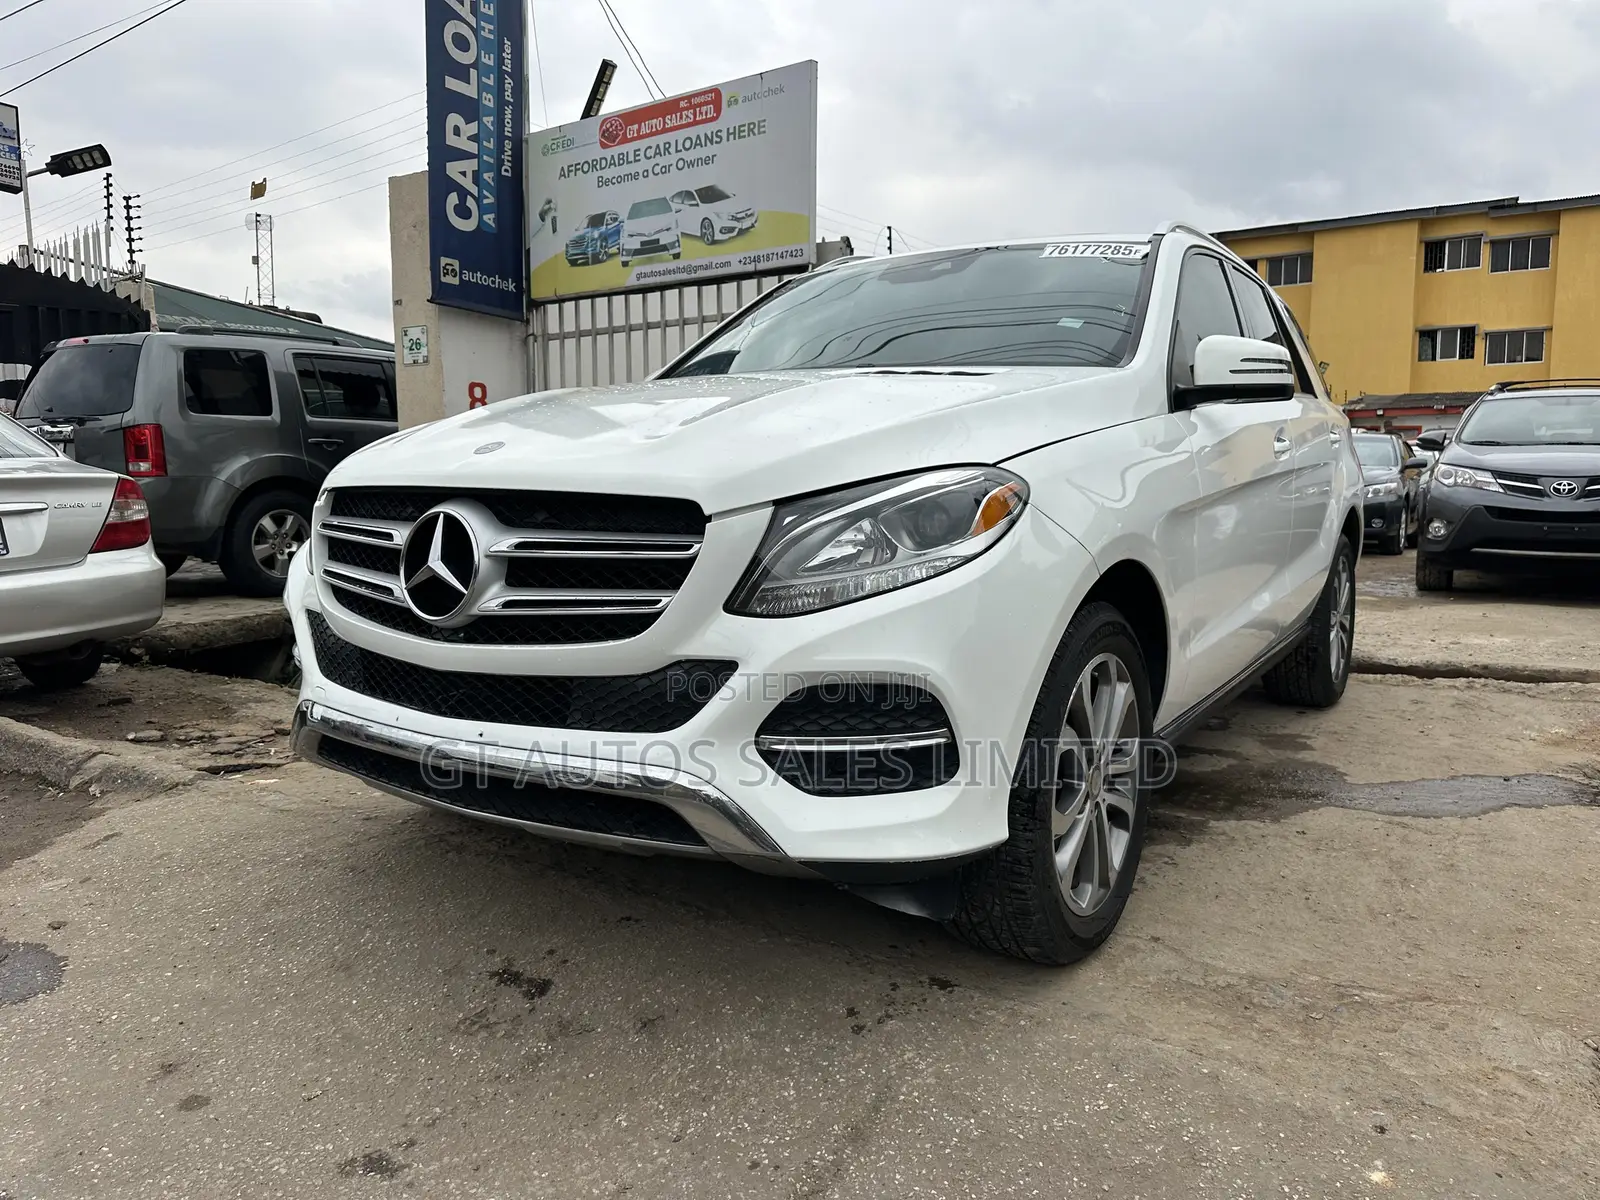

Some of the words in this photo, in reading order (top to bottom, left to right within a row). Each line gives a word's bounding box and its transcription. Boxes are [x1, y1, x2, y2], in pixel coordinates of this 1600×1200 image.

[502, 37, 512, 73] later
[504, 75, 514, 102] pay
[679, 98, 691, 109] RC.
[741, 84, 786, 104] autochek
[503, 105, 514, 138] now,
[626, 125, 640, 139] GT
[640, 117, 663, 136] AUTO
[665, 109, 694, 128] SALES
[695, 104, 717, 124] LTD.
[481, 51, 497, 228] AVAILABLE
[558, 148, 641, 180] AFFORDABLE
[643, 141, 672, 161] CAR
[675, 129, 723, 154] LOANS
[726, 119, 767, 142] HERE
[445, 113, 480, 232] CAR
[501, 140, 513, 177] Drive
[597, 170, 640, 189] Become
[642, 169, 650, 179] a
[652, 162, 673, 177] Car
[676, 153, 718, 172] Owner
[462, 269, 517, 293] autochek
[635, 259, 732, 282] gtautosalesltd@gmail.com
[738, 248, 804, 267] +2348187147423
[408, 338, 422, 351] 26
[468, 381, 489, 411] 8
[54, 502, 88, 510] CAMRY
